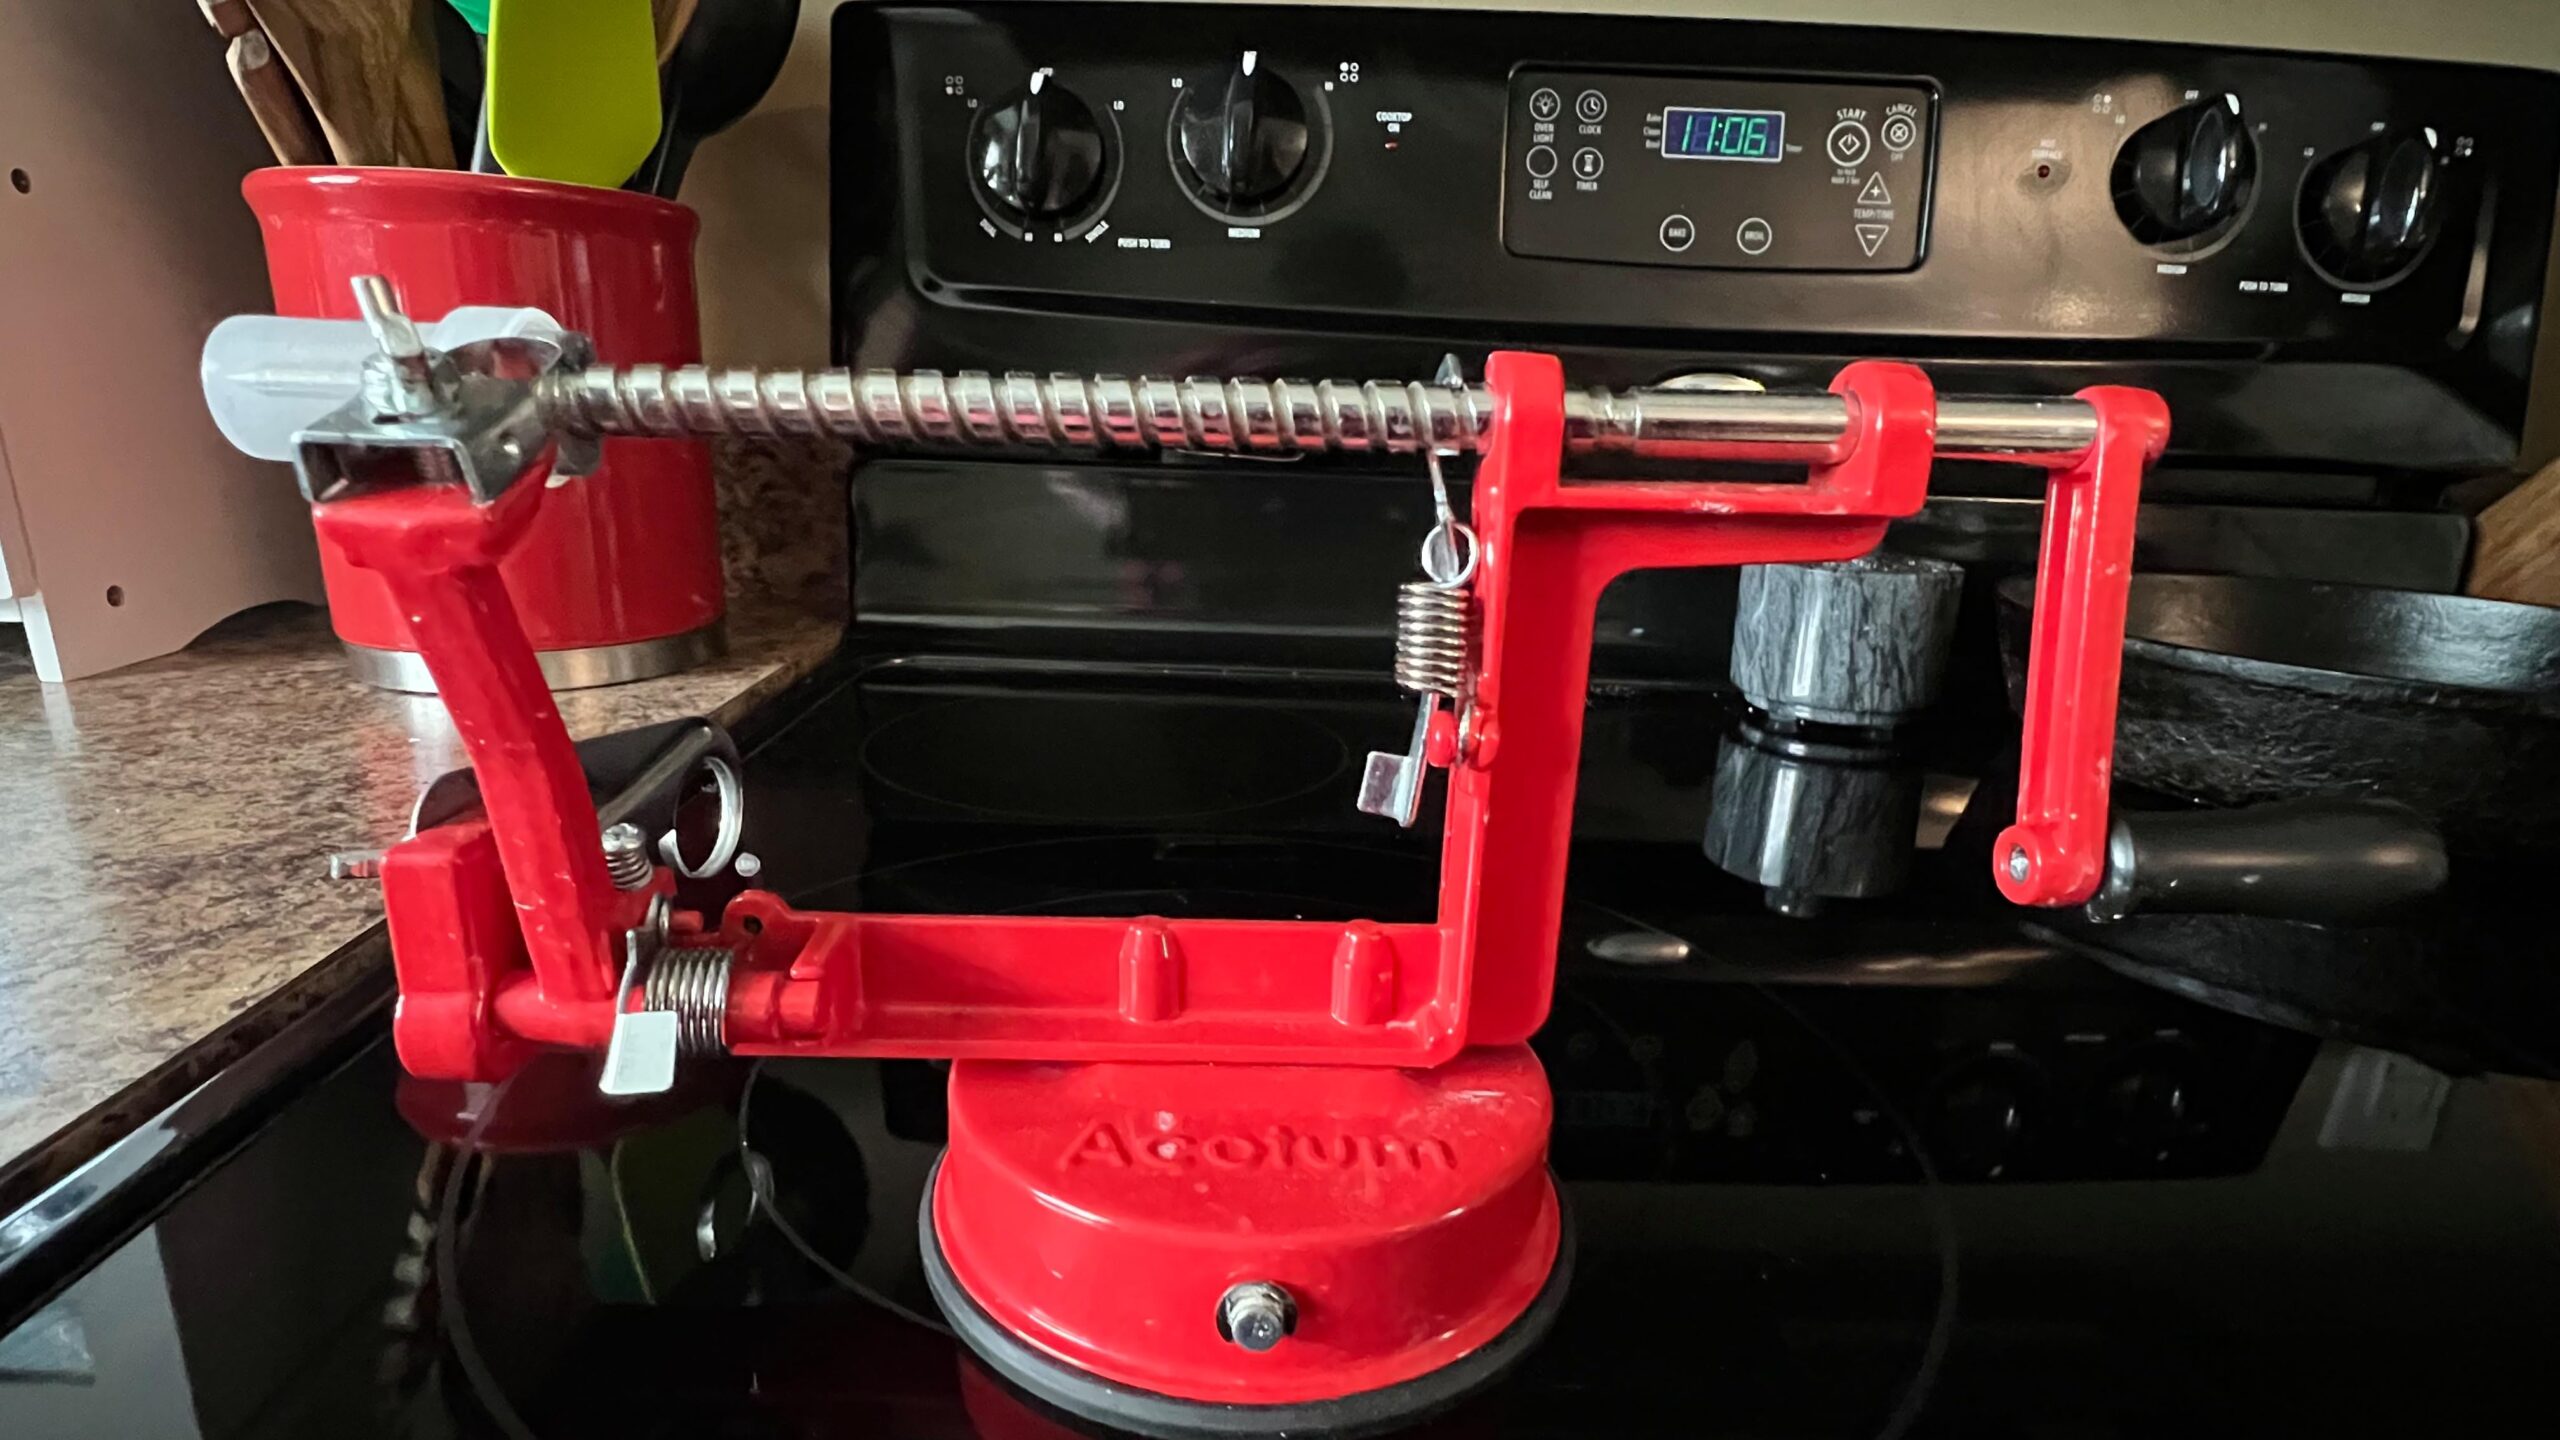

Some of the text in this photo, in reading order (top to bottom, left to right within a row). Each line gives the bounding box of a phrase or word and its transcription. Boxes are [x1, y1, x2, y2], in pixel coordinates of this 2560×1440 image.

[1171, 78, 1183, 88] LO
[1113, 100, 1125, 111] LO
[1886, 103, 1917, 117] CANCEL
[1836, 108, 1867, 121] START
[1534, 122, 1554, 132] OVEN
[1579, 124, 1602, 135] CLOCK
[1681, 114, 1769, 156] 11:06
[1529, 189, 1553, 200] CLEAN
